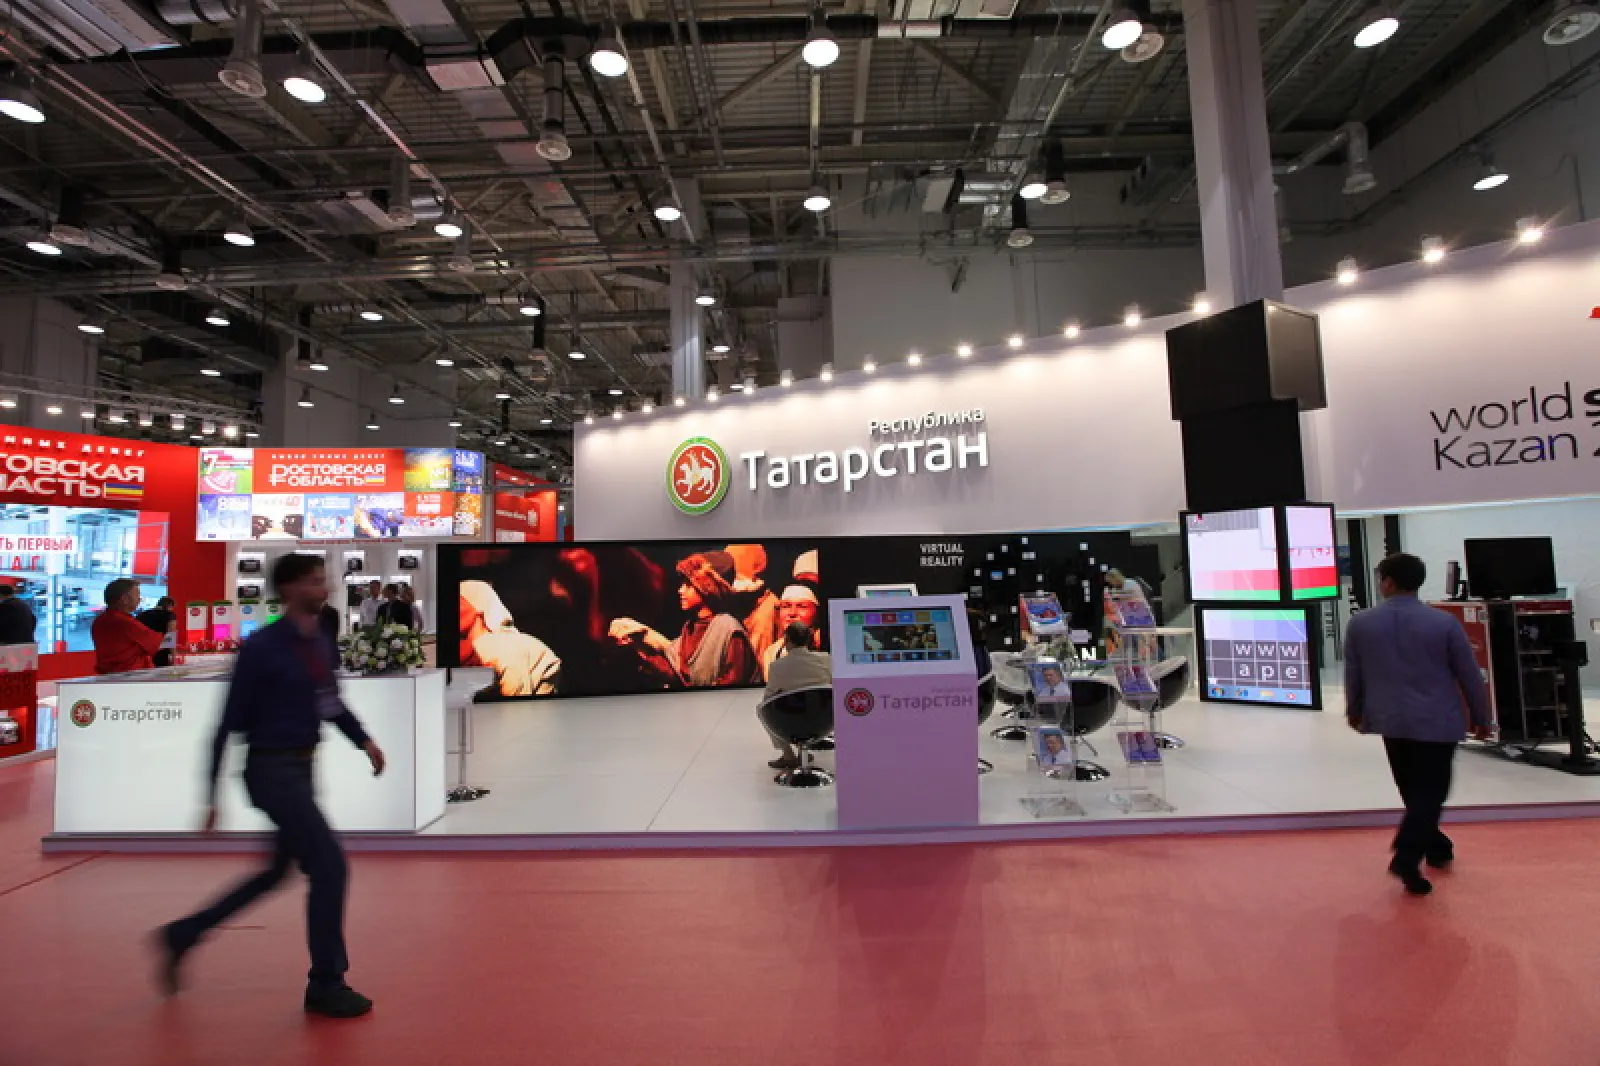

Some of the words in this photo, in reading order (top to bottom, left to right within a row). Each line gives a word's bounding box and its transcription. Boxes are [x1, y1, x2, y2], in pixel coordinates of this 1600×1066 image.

[1430, 380, 1574, 434] world
[868, 407, 985, 436] Республика
[1433, 432, 1579, 471] Kazan
[740, 431, 989, 493] Татарстан
[17, 535, 73, 551] ПЕРВЫЙ
[920, 543, 964, 554] VIRTUAL
[920, 556, 964, 567] REALITY
[879, 693, 973, 712] Татарстан
[101, 706, 183, 724] Татарстан
